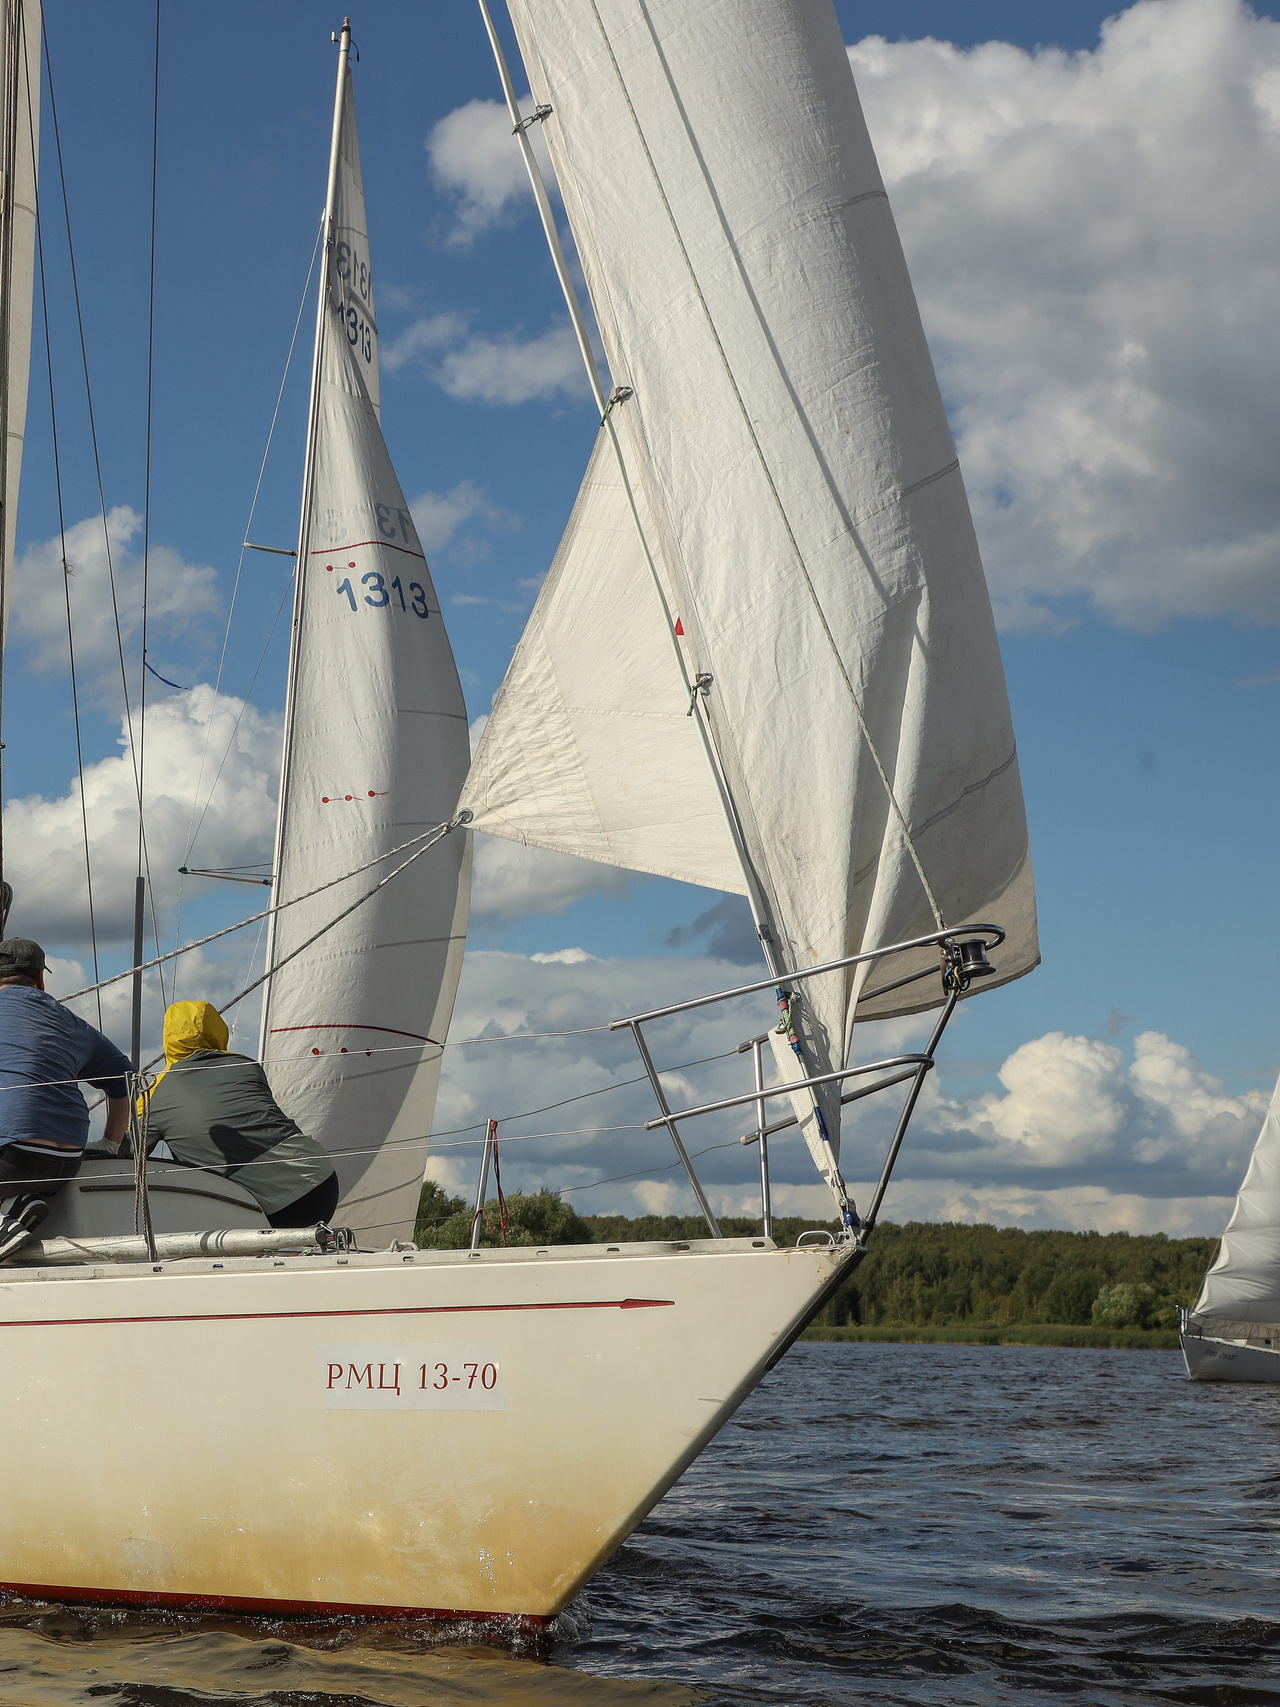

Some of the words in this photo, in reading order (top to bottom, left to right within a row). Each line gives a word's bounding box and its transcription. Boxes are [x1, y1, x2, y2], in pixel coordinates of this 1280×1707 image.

[337, 301, 371, 364] 1313
[336, 571, 429, 619] 1313
[325, 1363, 402, 1397] РМЦ
[419, 1362, 498, 1390] 13-70
